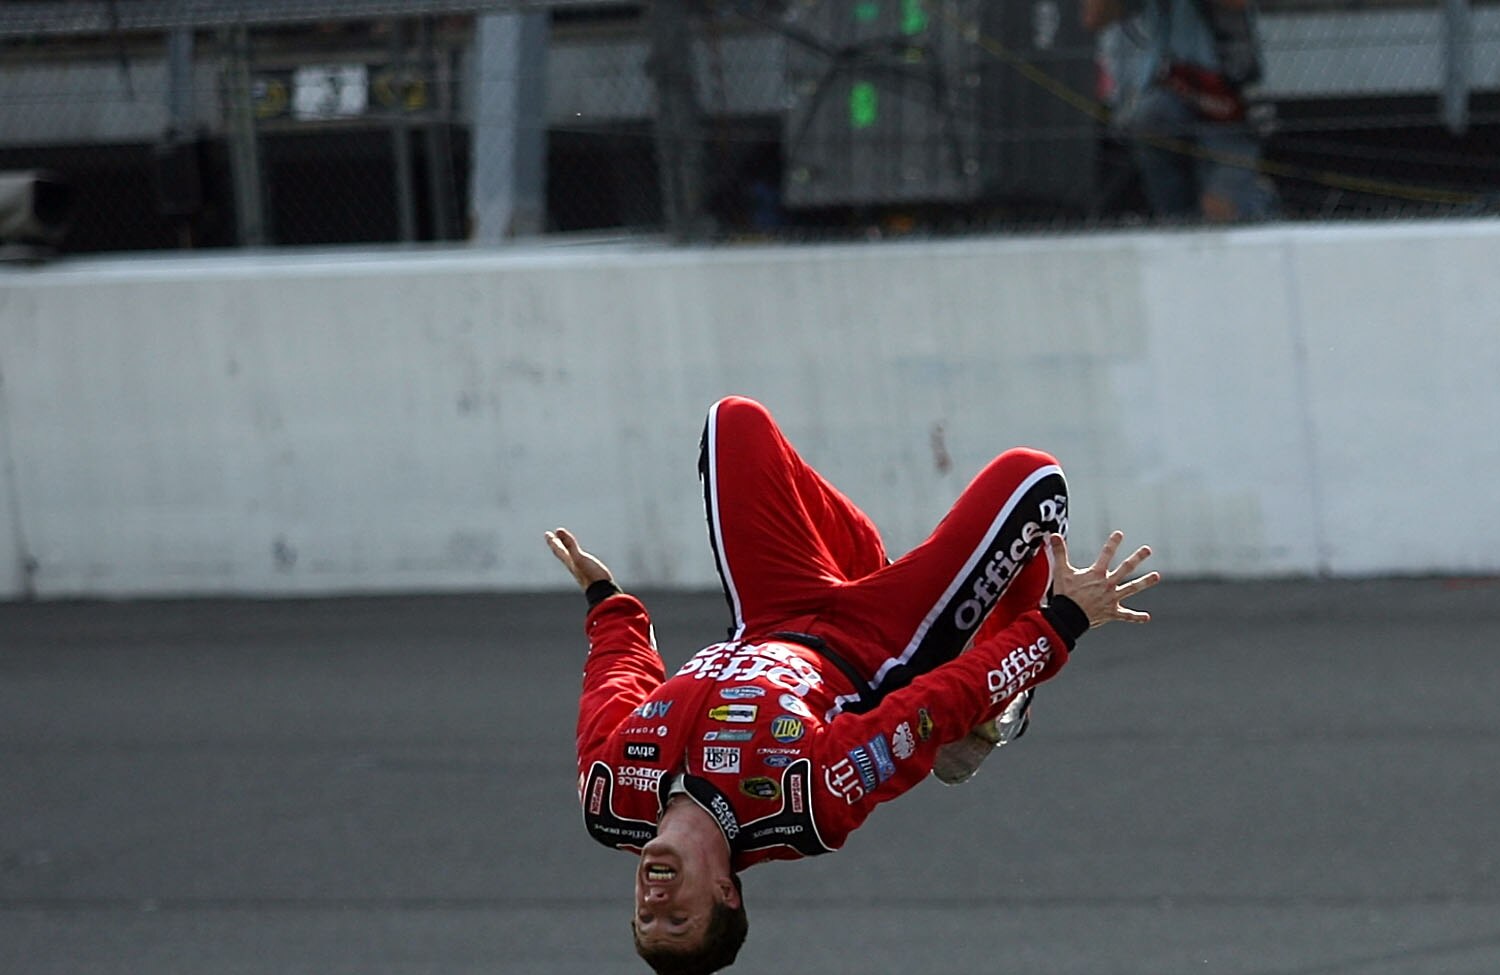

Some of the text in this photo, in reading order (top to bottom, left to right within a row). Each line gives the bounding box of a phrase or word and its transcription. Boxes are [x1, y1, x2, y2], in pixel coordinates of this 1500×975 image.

[954, 521, 1044, 630] Office
[675, 656, 811, 697] Offic
[987, 636, 1051, 692] Office
[774, 719, 802, 738] RITZ
[627, 746, 655, 758] ativa
[616, 766, 660, 778] DEPOT
[617, 776, 659, 793] Office
[825, 758, 863, 804] citi
